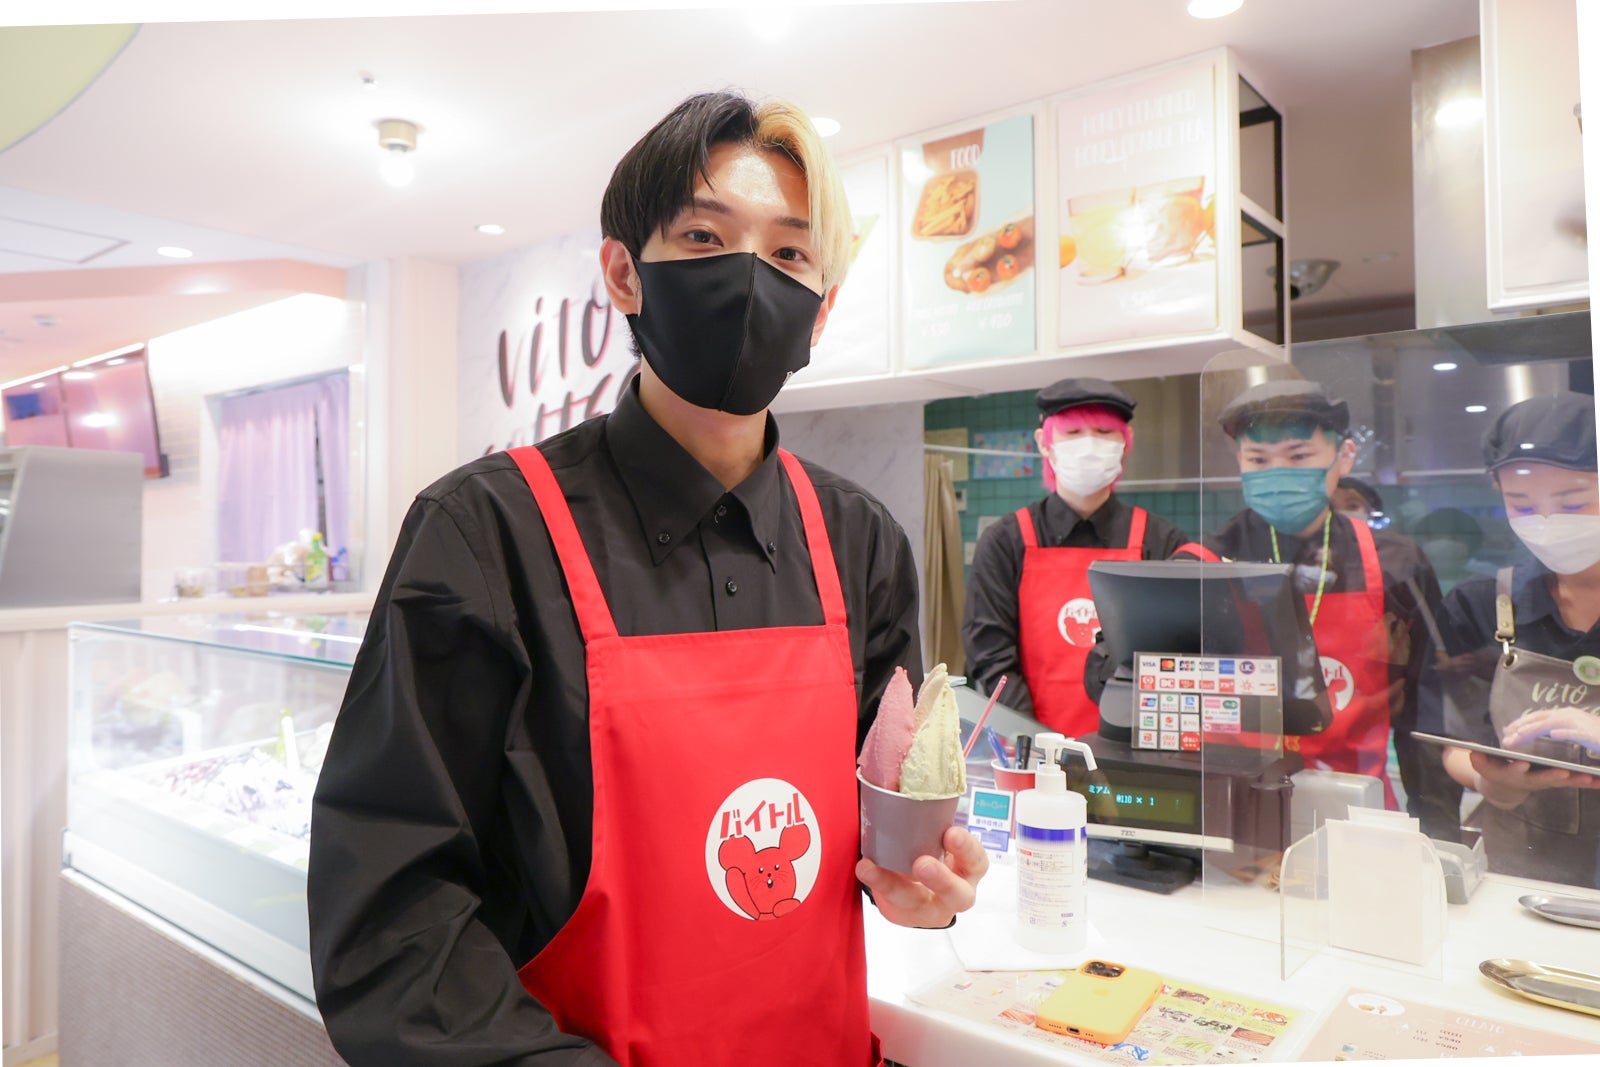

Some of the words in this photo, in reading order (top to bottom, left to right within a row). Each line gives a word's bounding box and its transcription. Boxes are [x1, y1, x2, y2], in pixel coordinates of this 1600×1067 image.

[950, 143, 981, 169] FOOD
[719, 792, 805, 839] バイトル
